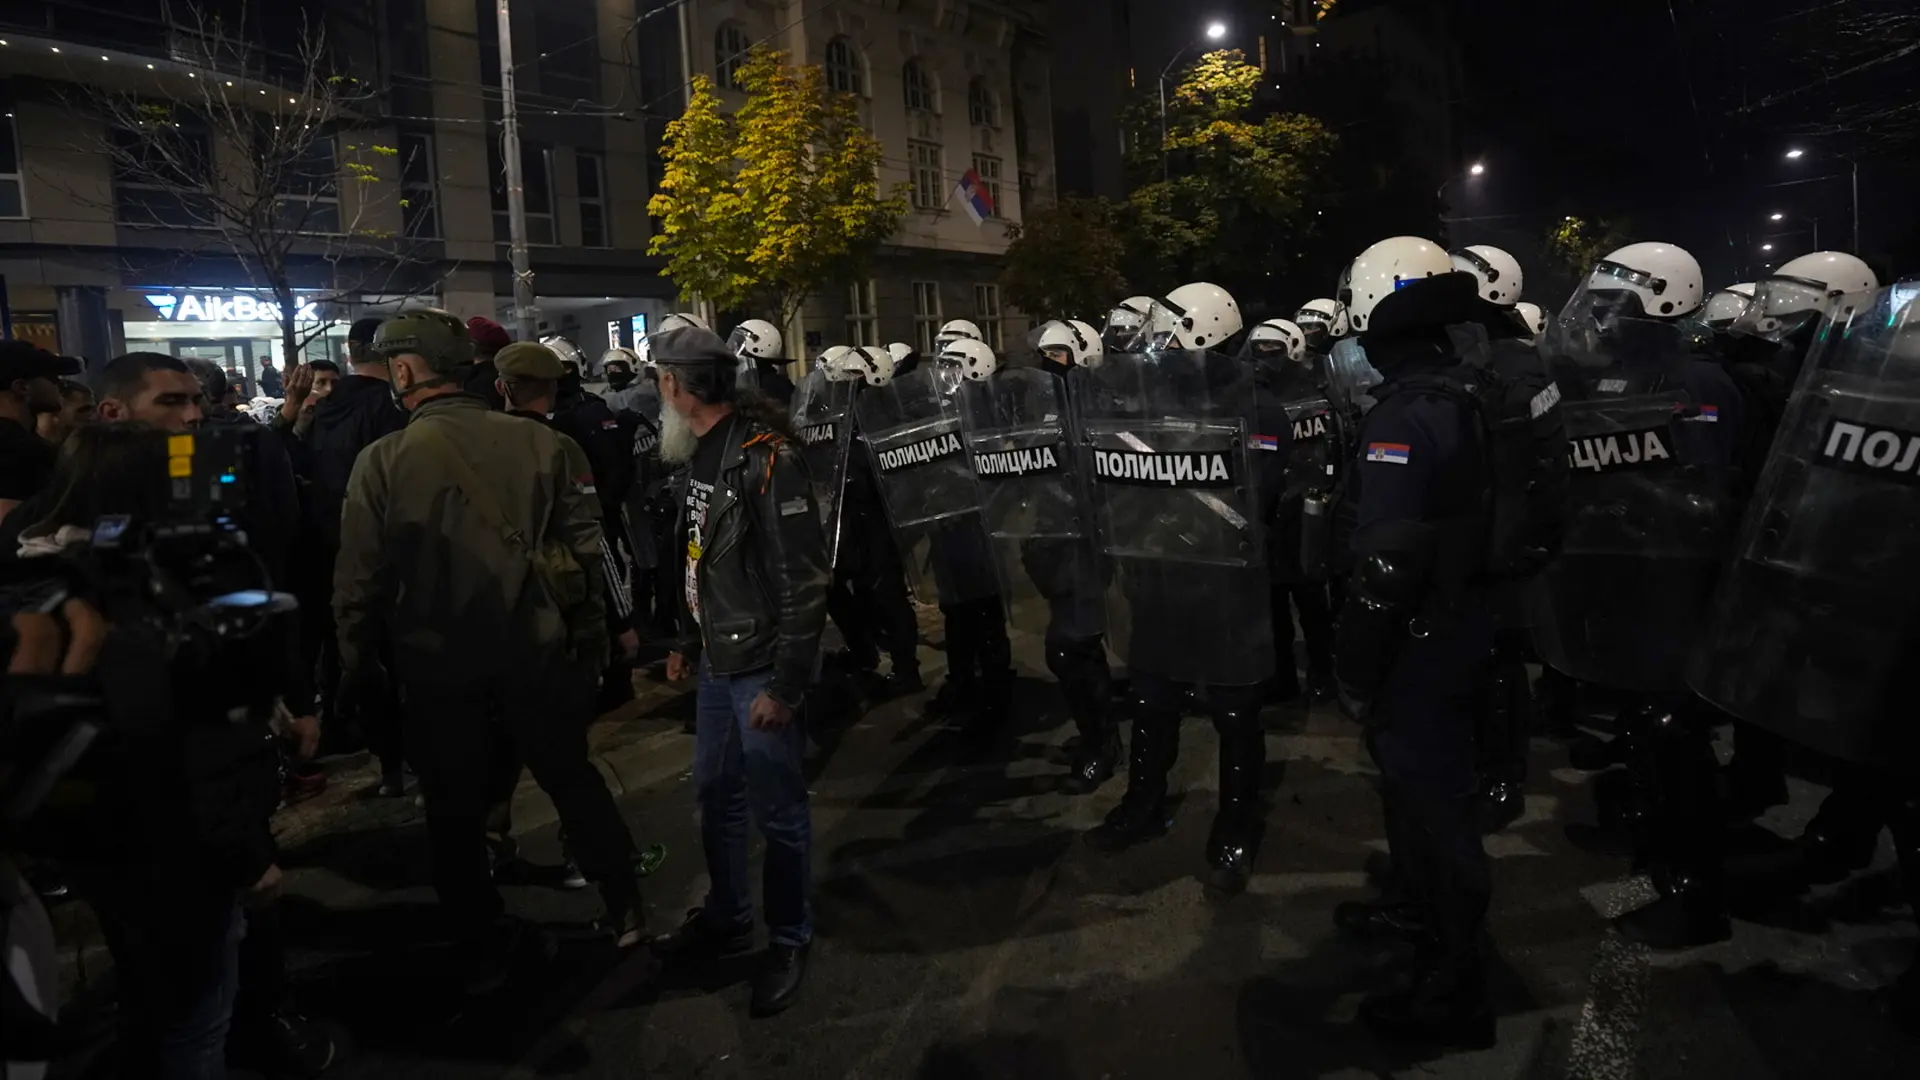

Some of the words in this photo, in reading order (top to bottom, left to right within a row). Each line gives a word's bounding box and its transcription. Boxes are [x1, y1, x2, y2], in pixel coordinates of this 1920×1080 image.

[878, 433, 961, 471] ПОЛИЦИЈА
[974, 446, 1057, 475] ПОЛИЦИЈА
[1095, 450, 1229, 486] ПОЛИЦИЈА
